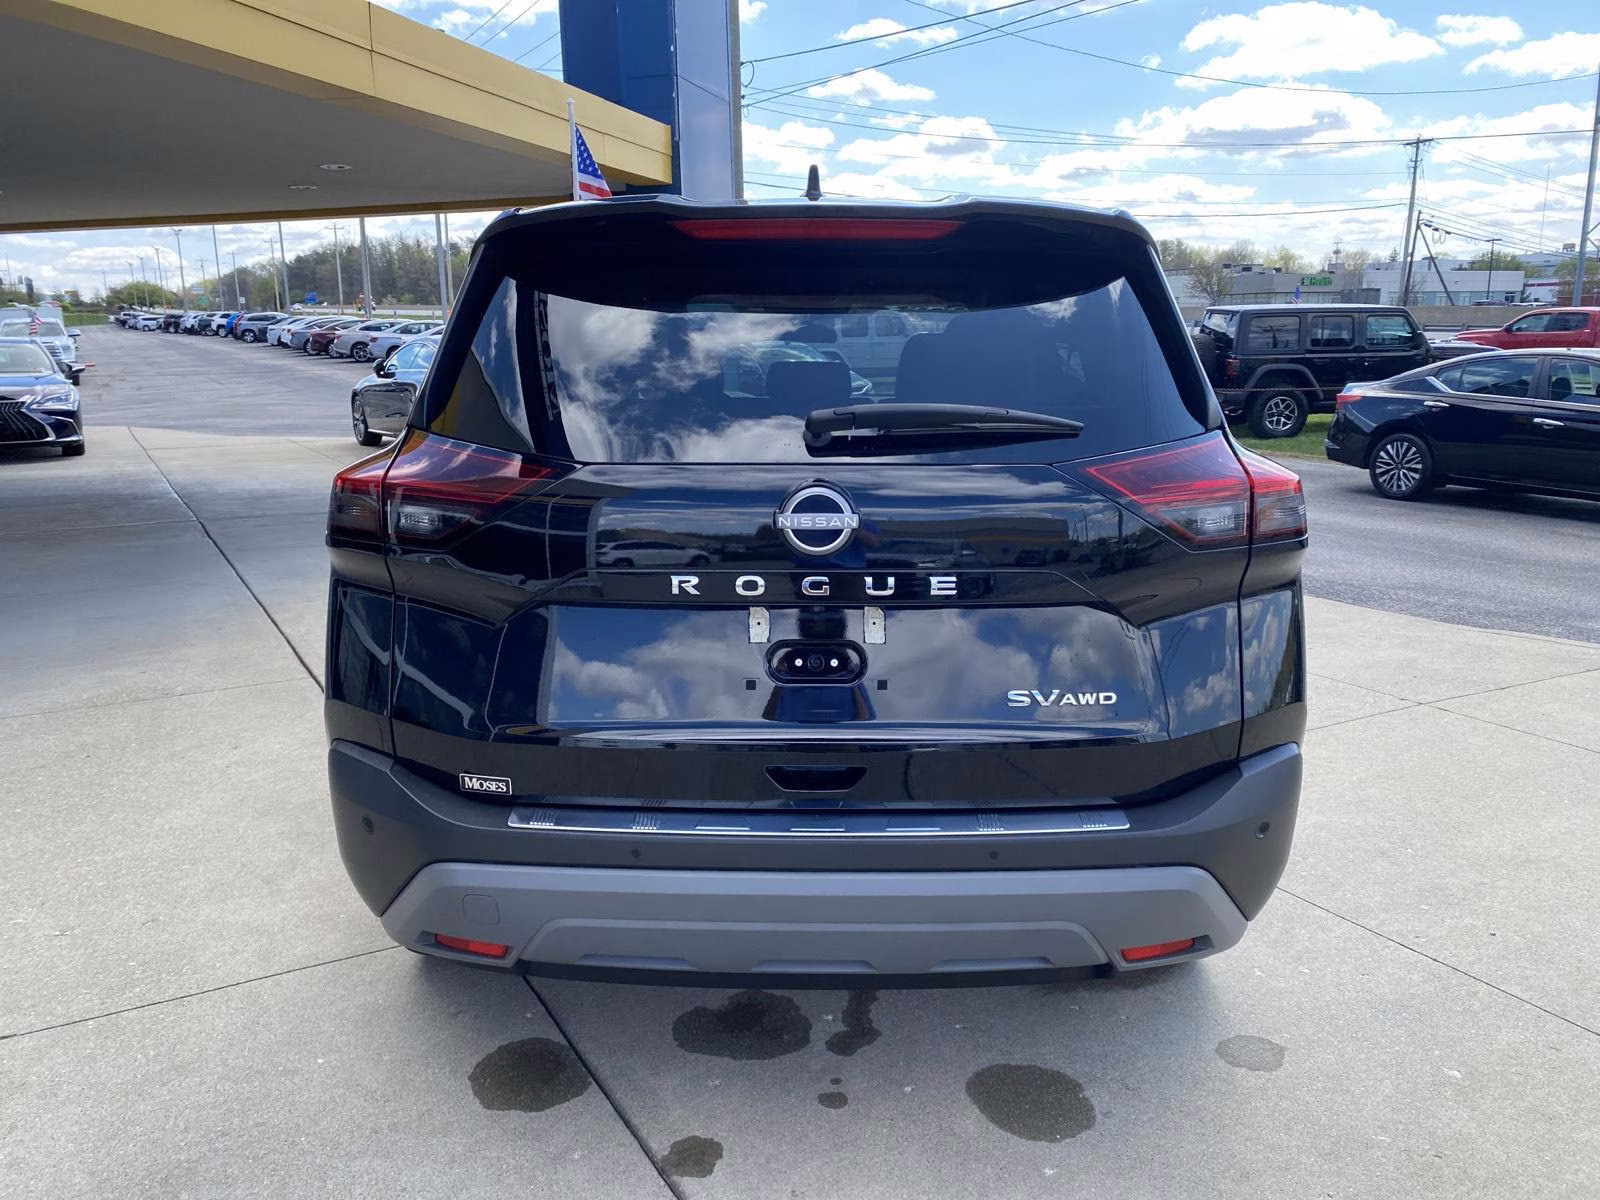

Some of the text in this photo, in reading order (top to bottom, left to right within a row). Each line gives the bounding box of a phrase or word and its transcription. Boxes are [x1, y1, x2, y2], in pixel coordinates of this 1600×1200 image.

[778, 516, 857, 527] NISSAN
[670, 575, 958, 596] ROGUE
[1007, 689, 1117, 707] SV AWD
[463, 776, 507, 793] MOSES
